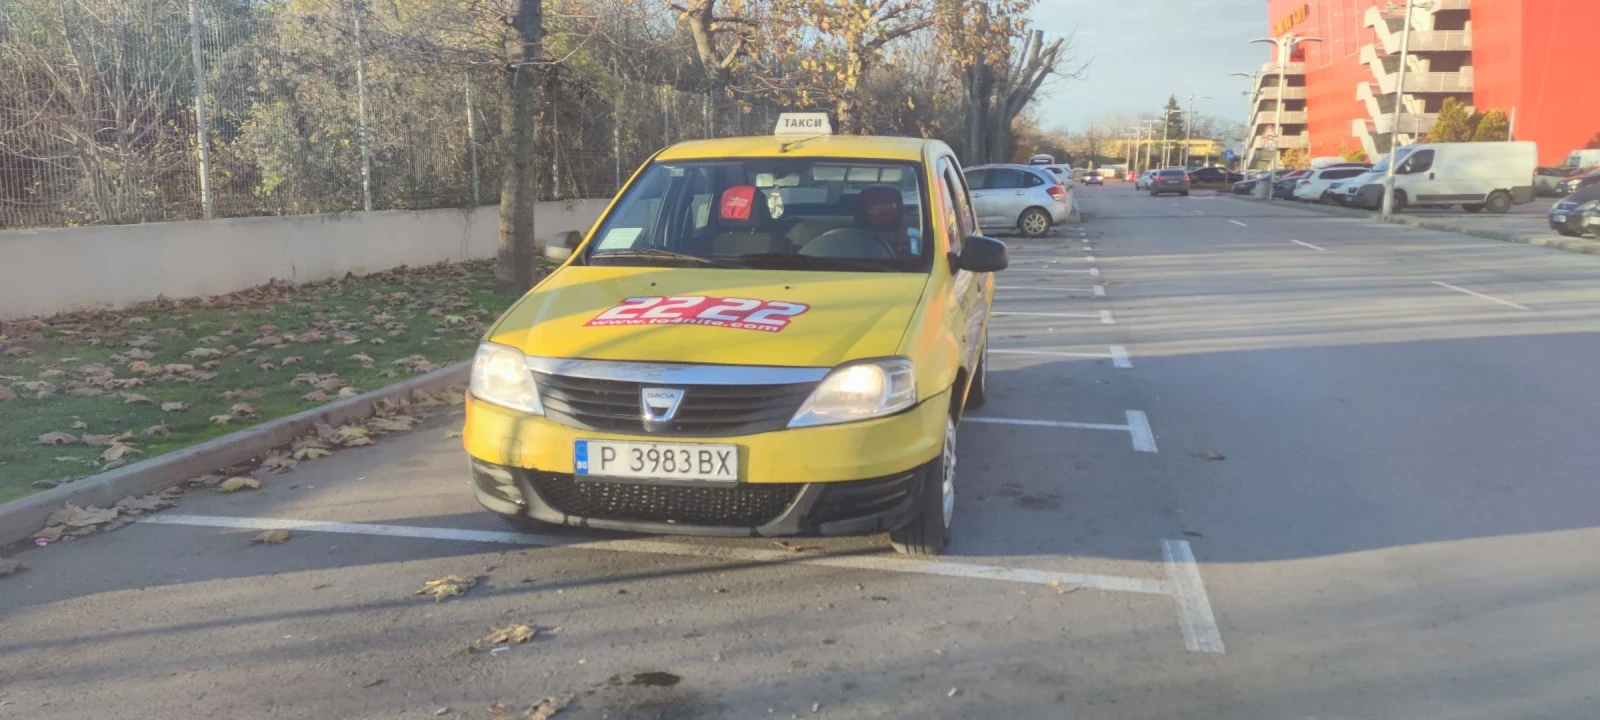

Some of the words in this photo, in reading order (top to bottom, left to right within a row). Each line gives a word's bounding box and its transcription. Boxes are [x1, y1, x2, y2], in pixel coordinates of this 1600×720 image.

[783, 118, 822, 128] ТАКСИ
[596, 296, 706, 319] 22
[696, 297, 808, 326] 22
[591, 317, 779, 332] www.to4nite.com
